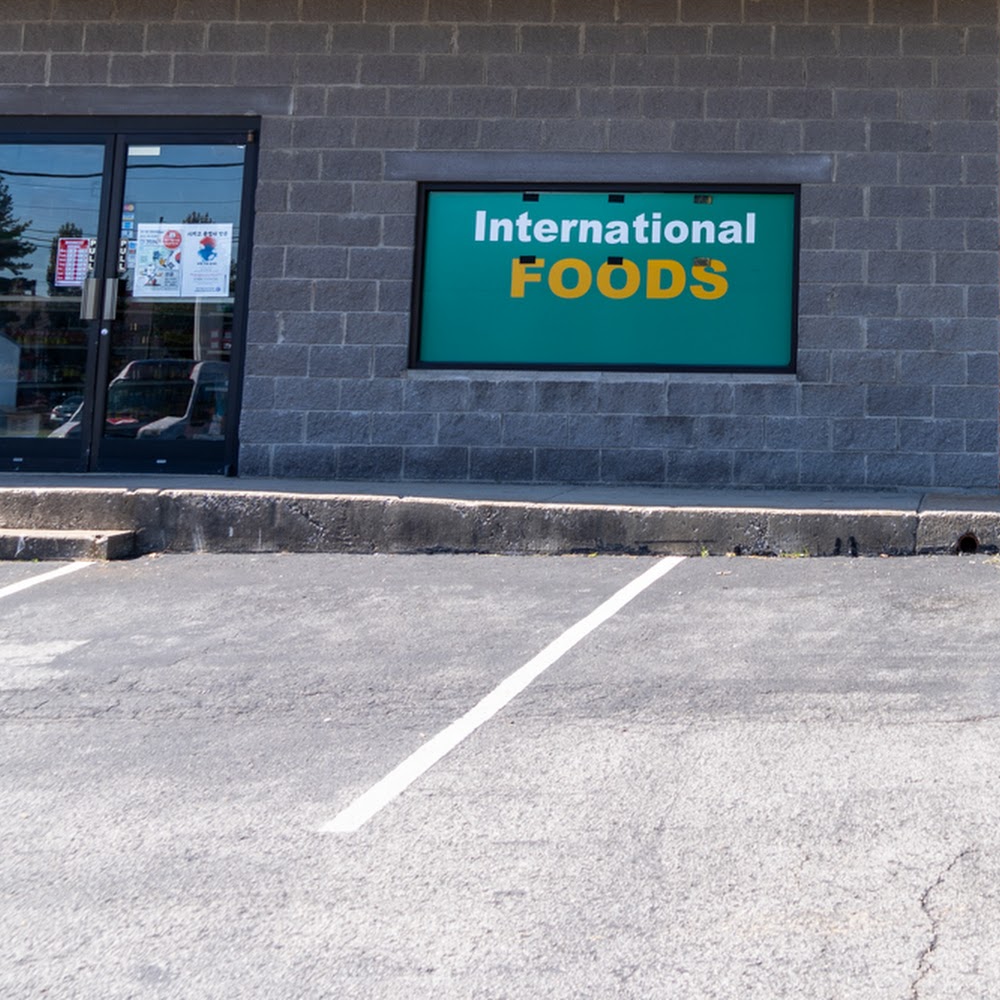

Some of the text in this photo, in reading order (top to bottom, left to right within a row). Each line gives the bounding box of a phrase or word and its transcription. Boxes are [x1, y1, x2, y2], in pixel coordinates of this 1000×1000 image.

[474, 210, 756, 244] International
[88, 240, 97, 271] PULL
[118, 240, 127, 271] PULL
[510, 258, 728, 300] FOODS
